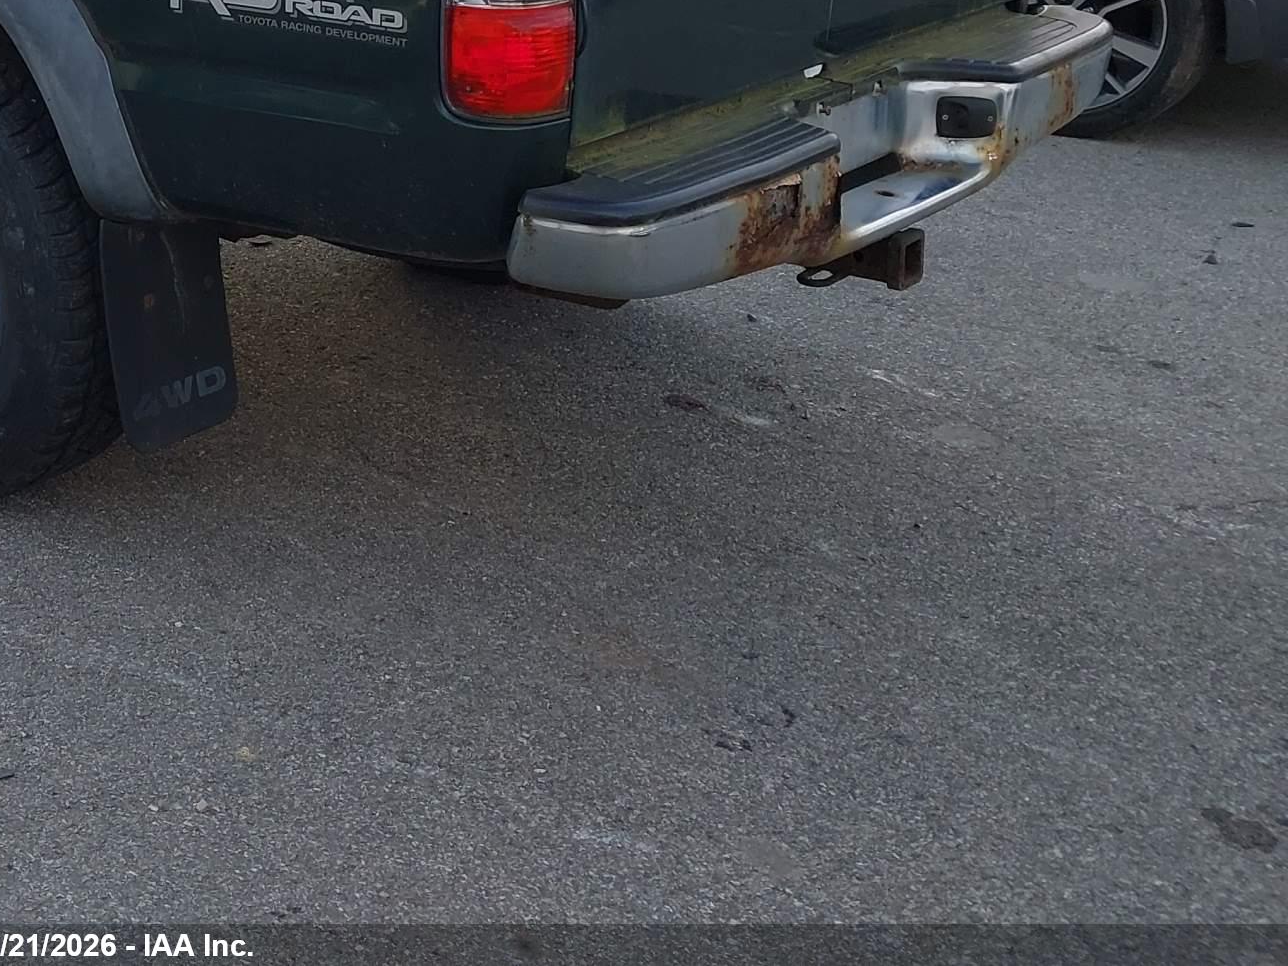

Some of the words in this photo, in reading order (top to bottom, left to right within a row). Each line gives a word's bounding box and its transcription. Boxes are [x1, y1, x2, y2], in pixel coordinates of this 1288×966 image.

[238, 13, 279, 30] TOYOTA
[280, 20, 322, 35] RACING
[325, 26, 409, 48] DEVELOPMENT
